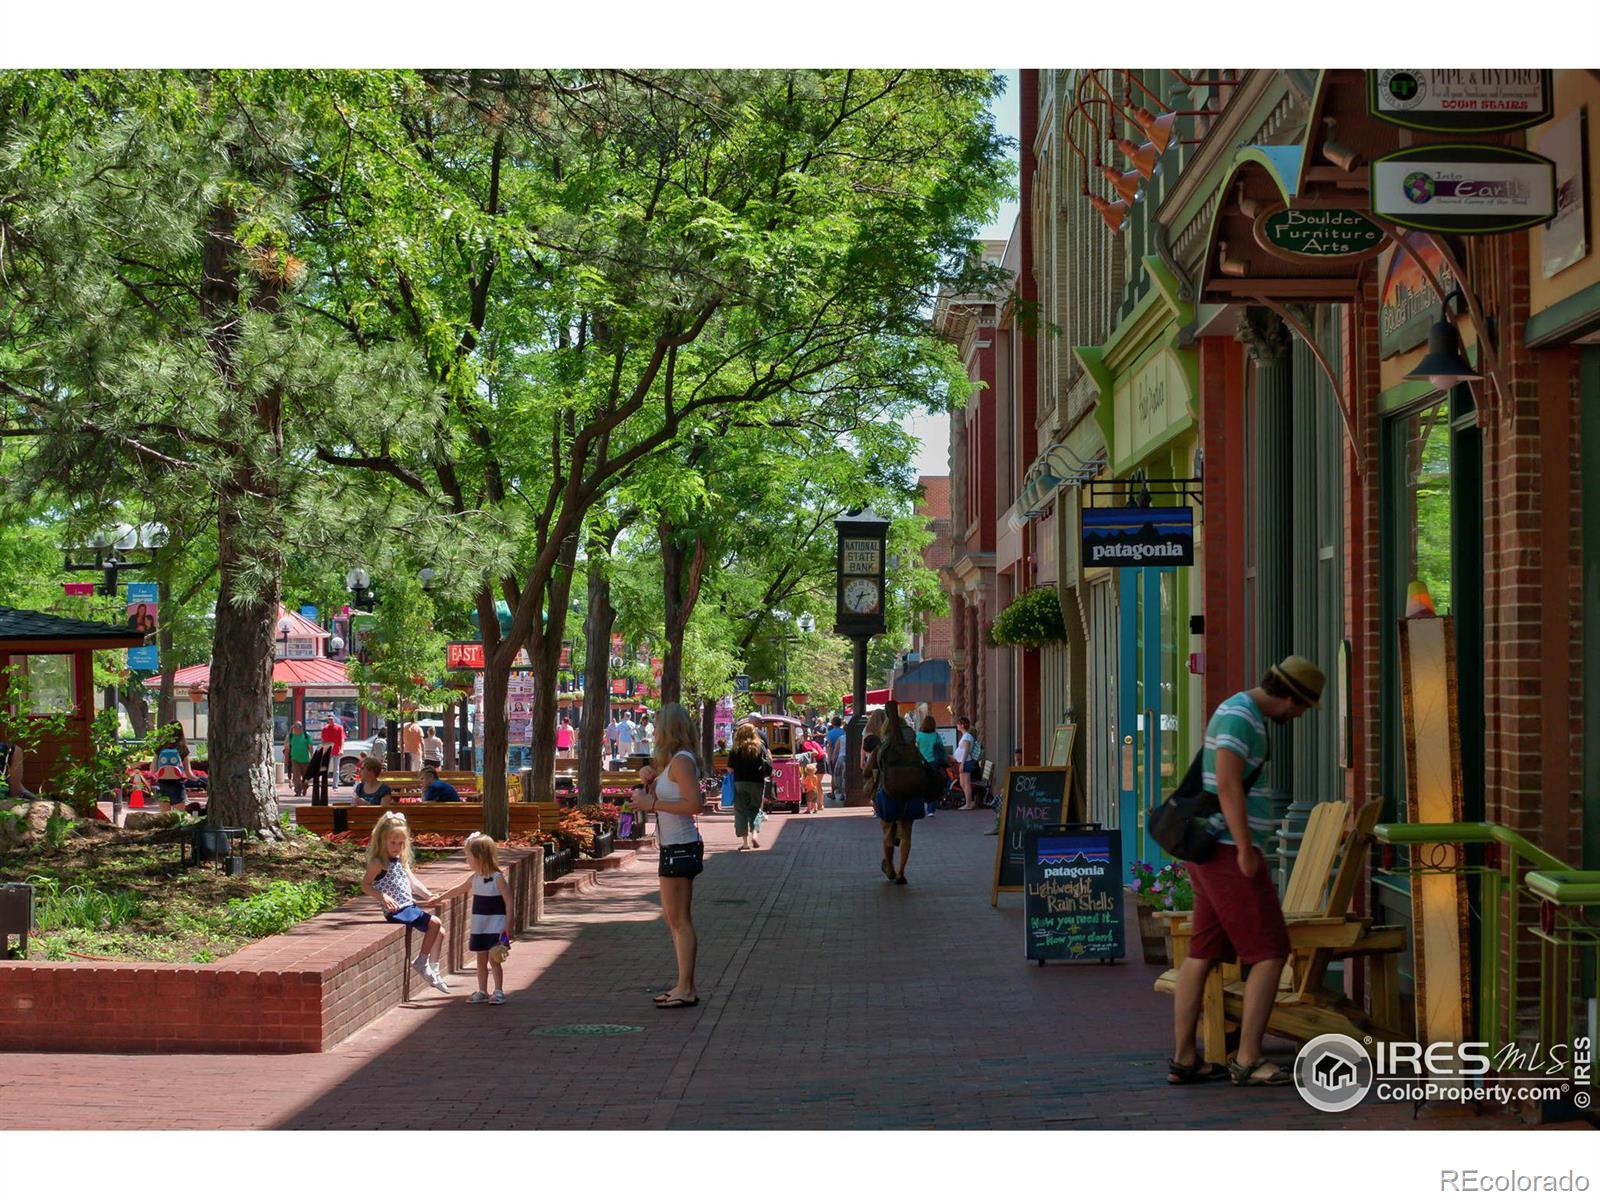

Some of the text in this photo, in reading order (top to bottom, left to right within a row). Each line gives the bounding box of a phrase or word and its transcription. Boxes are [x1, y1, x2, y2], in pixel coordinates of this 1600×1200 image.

[1435, 171, 1463, 180] Into
[1287, 210, 1363, 225] Boulder
[1275, 224, 1376, 240] Furniture
[1302, 238, 1350, 252] Arts
[845, 541, 881, 551] NATIONAL
[1092, 541, 1185, 561] patagonia
[848, 552, 876, 562] STATE
[849, 563, 874, 573] BANK
[451, 647, 479, 662] EAST
[1016, 805, 1050, 819] MADE
[1043, 864, 1105, 879] patagonia
[1028, 877, 1093, 898] Lightweight
[1047, 891, 1115, 913] Rain Shells
